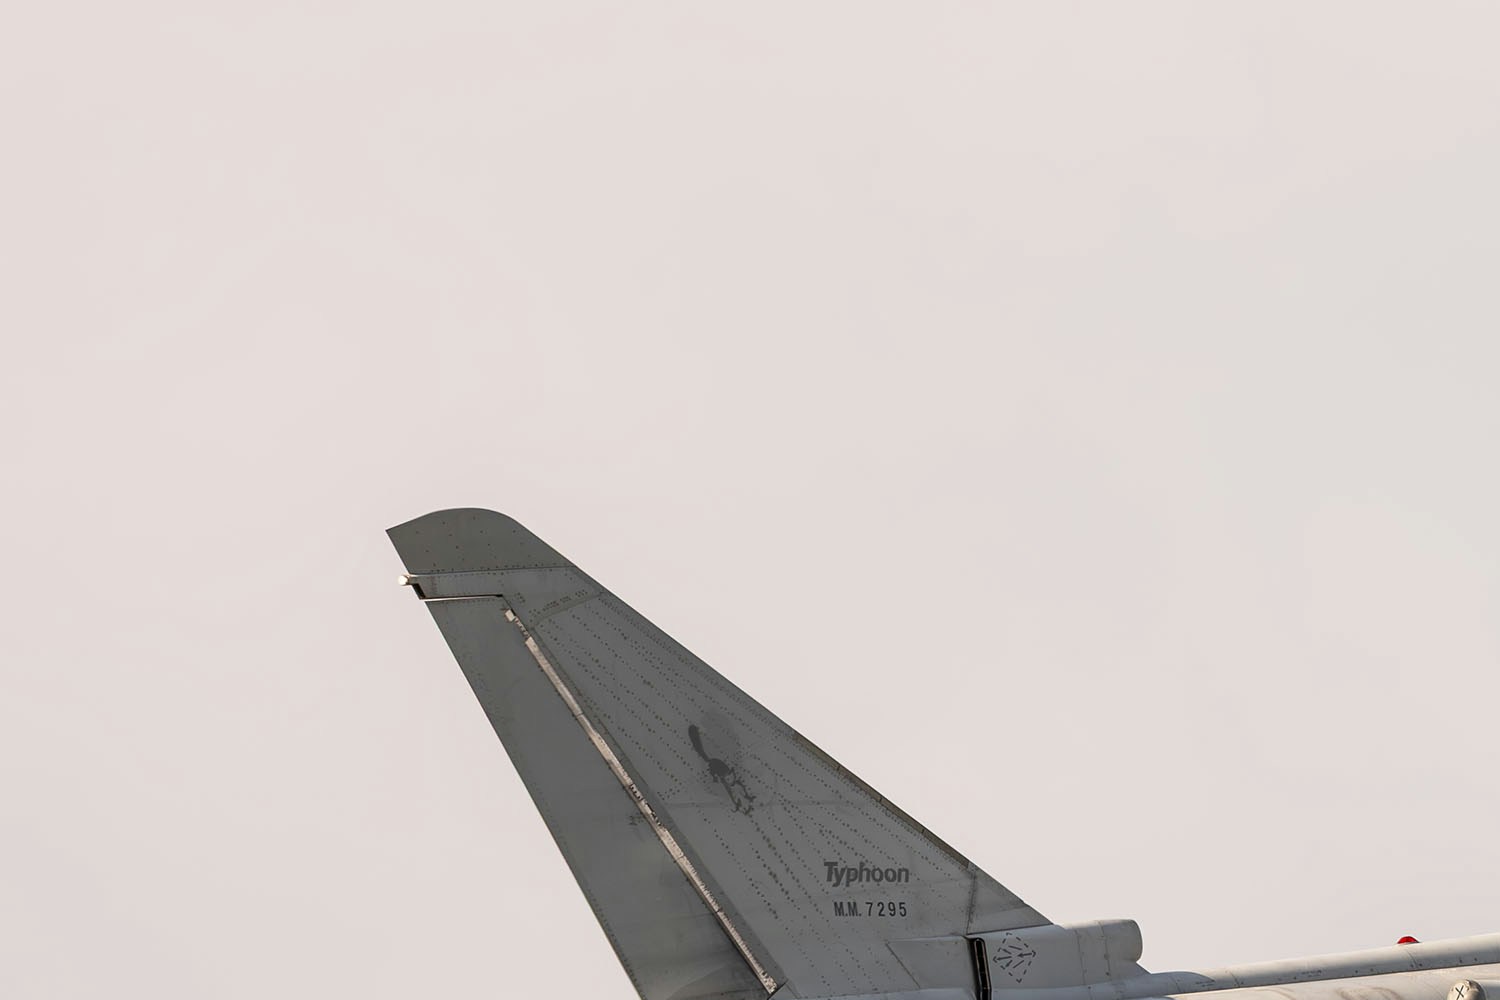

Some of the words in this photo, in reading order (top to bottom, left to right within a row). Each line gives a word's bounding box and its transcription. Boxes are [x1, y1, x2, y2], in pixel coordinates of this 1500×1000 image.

[823, 861, 910, 887] Typhoon
[833, 901, 862, 917] M.M.
[865, 901, 907, 917] 7295
